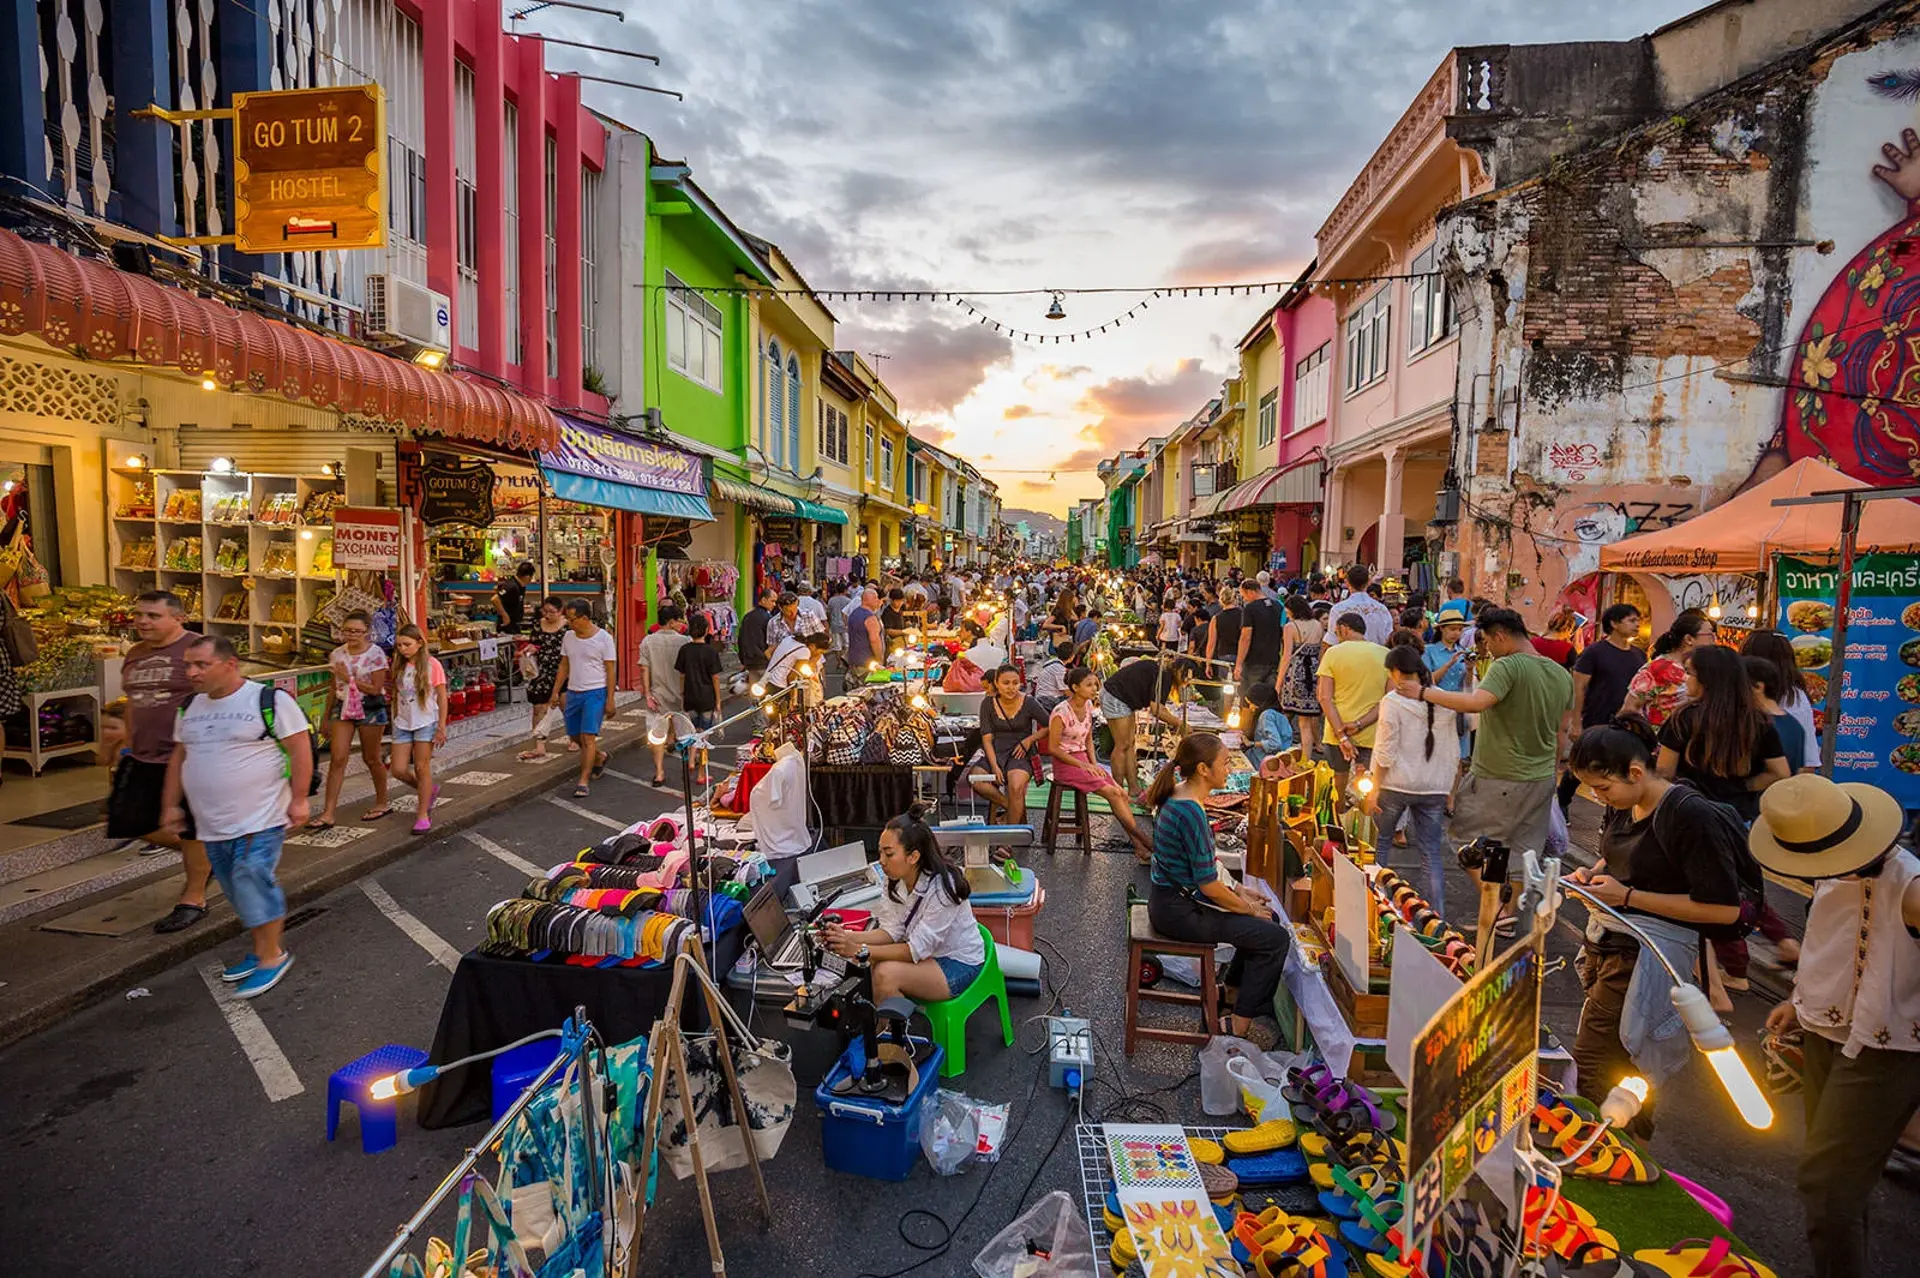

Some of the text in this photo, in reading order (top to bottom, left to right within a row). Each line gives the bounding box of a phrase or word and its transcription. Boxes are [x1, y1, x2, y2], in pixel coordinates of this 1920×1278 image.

[254, 115, 363, 148] GO TUM 2
[270, 176, 346, 201] HOSTEL
[429, 477, 468, 490] GOTUM
[336, 529, 399, 542] MONEY
[335, 542, 399, 556] EXCHANGE
[1691, 547, 1717, 569] Shop
[1861, 690, 1890, 702] soup
